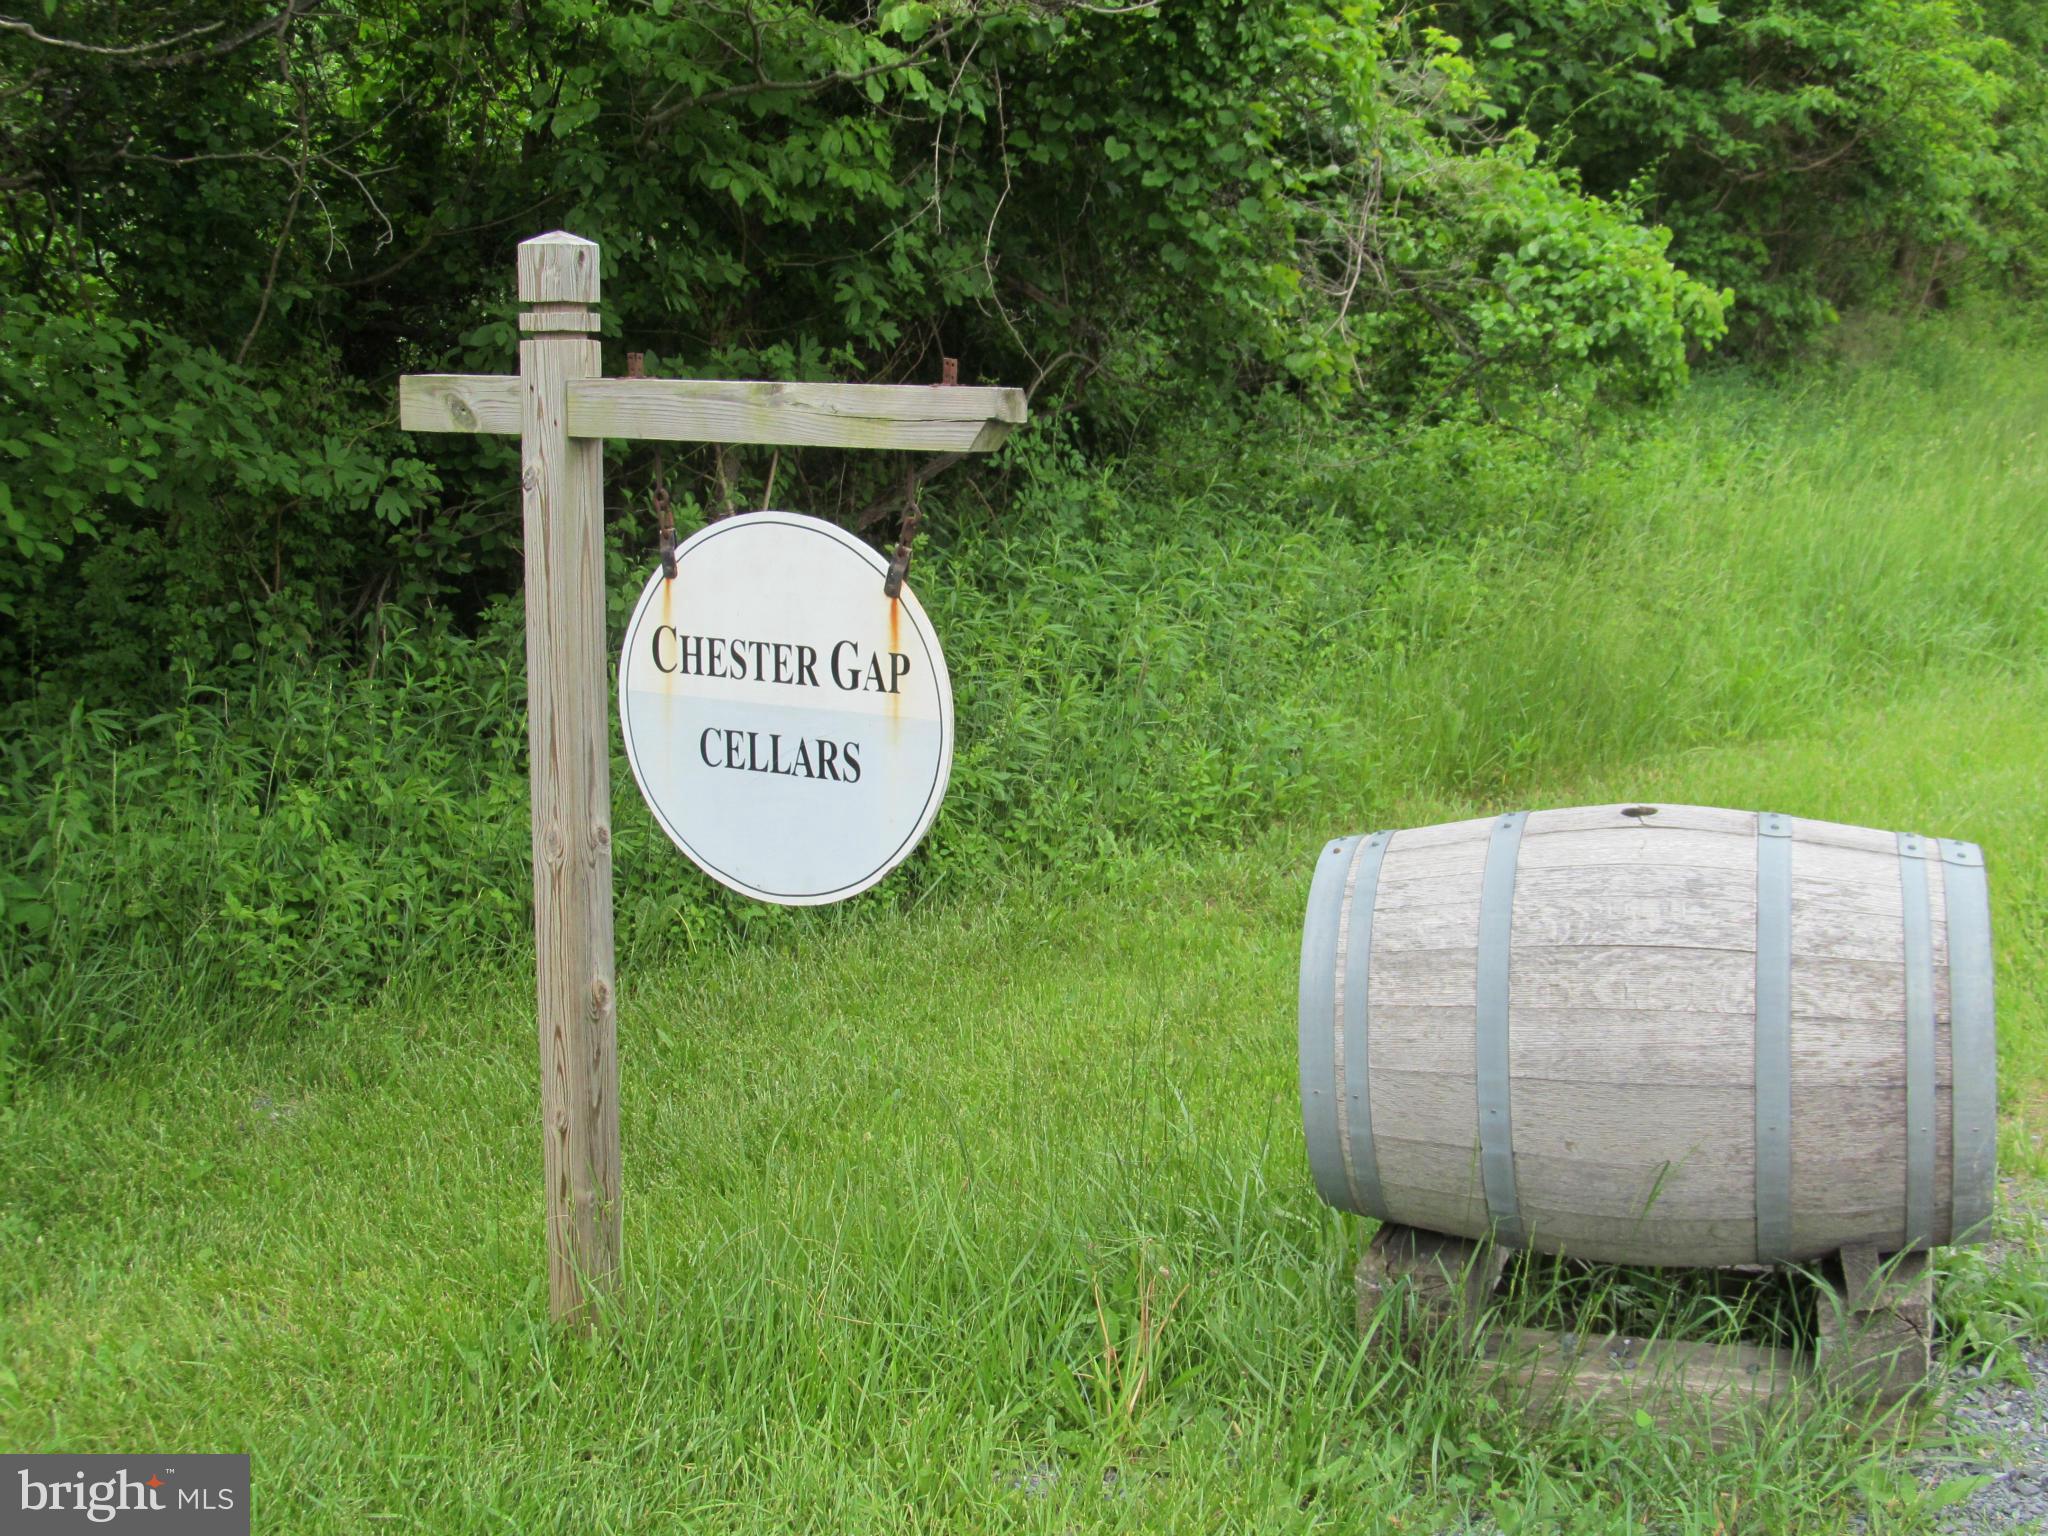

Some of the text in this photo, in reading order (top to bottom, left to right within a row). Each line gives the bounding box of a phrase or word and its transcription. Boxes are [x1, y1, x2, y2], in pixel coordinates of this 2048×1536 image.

[652, 625, 911, 694] CHESTER GAP
[700, 727, 861, 784] CELLARS
